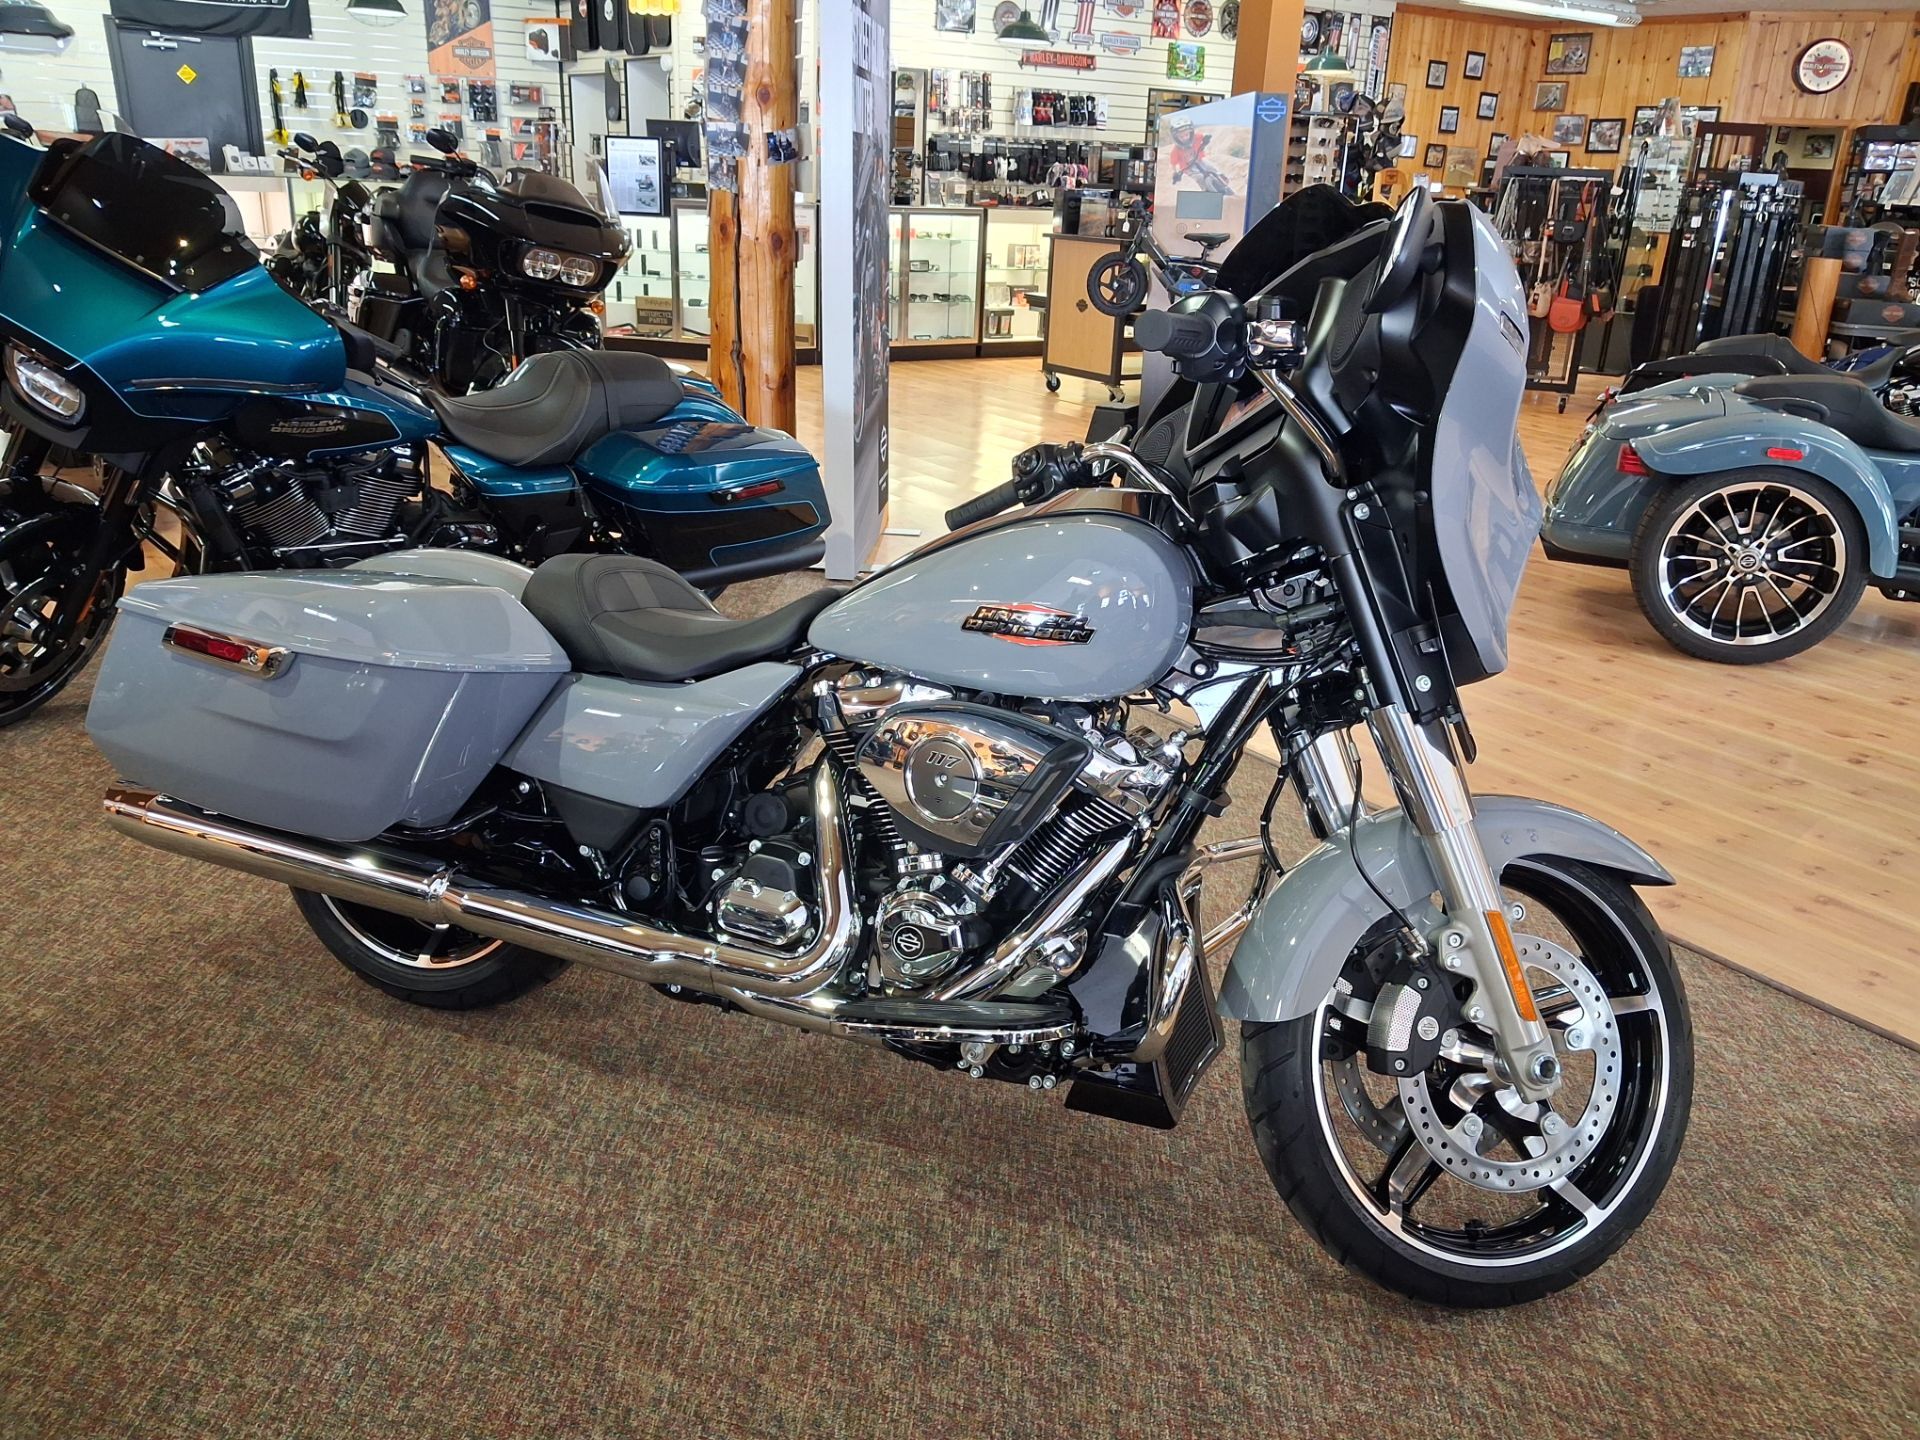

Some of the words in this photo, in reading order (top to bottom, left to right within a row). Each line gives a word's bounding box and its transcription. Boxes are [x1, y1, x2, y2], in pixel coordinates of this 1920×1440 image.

[270, 425, 345, 433] DAVIDSON
[978, 608, 1087, 627] HAREY-
[966, 619, 1089, 641] DAVIDSON
[926, 752, 962, 768] 117
